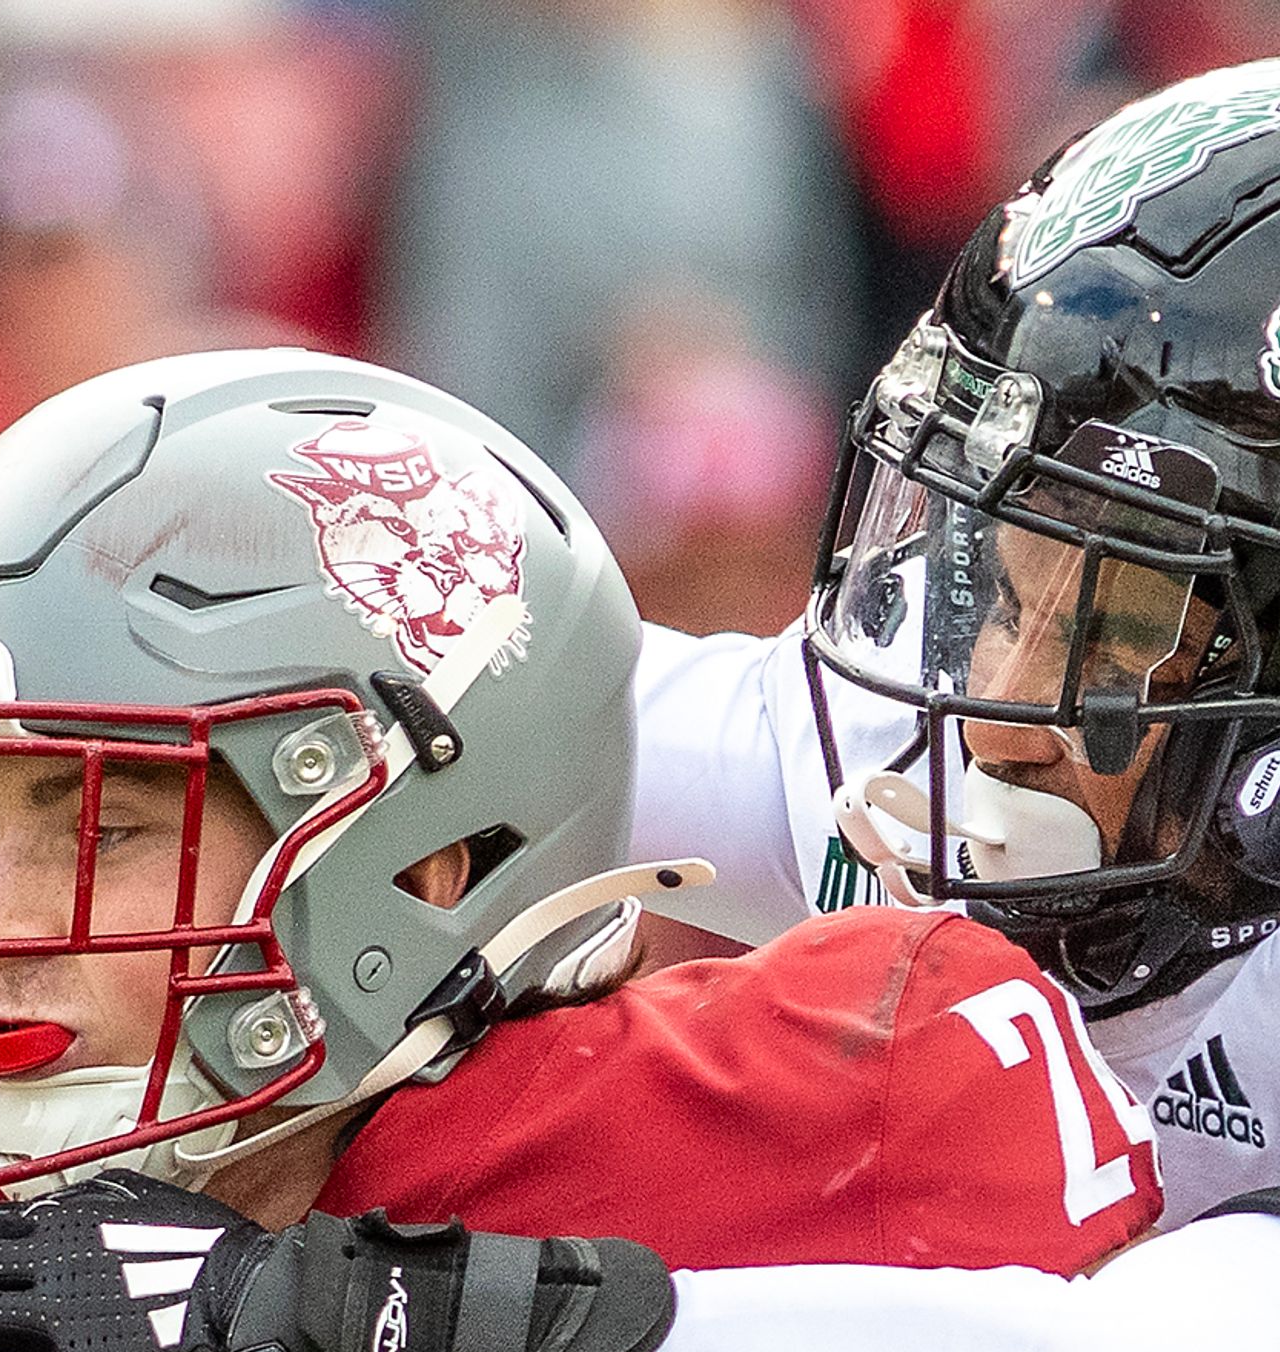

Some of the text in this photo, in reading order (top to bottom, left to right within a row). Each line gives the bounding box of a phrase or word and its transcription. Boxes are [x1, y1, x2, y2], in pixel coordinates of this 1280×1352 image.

[321, 454, 434, 492] WSC
[1101, 458, 1161, 490] adidas
[1250, 756, 1280, 809] schutt
[1152, 1093, 1266, 1149] adidas
